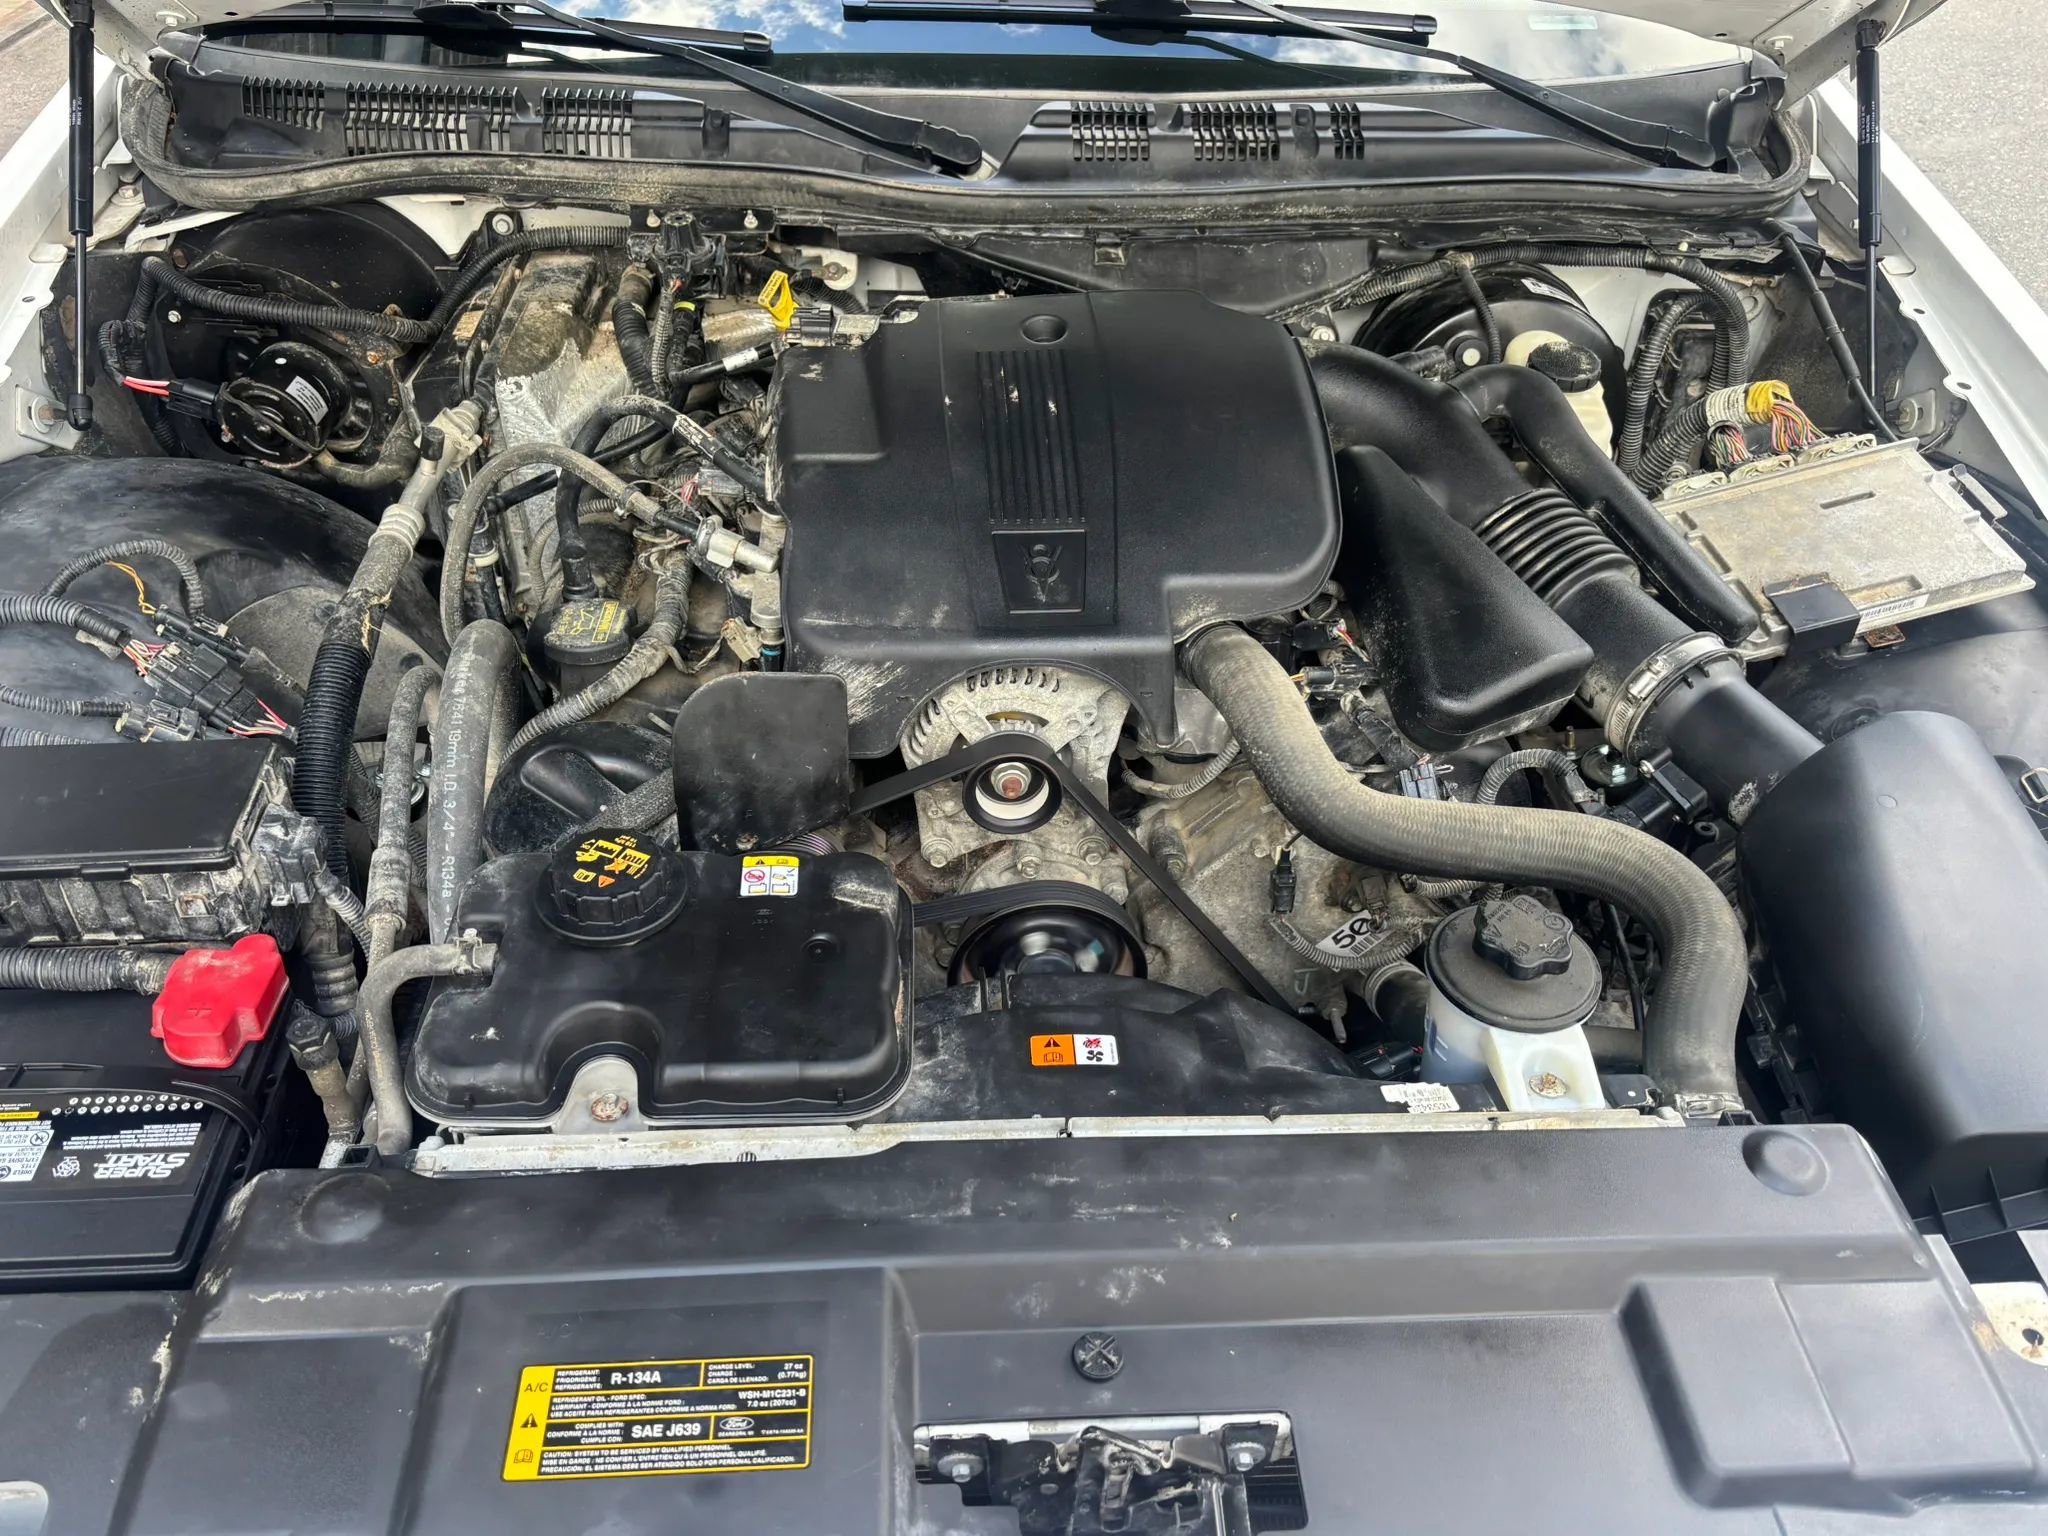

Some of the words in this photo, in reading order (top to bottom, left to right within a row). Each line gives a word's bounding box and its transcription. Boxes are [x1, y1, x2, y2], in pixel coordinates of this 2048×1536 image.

[446, 729, 462, 768] 19mm
[442, 856, 456, 898] R134a
[104, 1152, 191, 1167] START
[93, 1166, 174, 1179] SUPER
[611, 1371, 661, 1385] R-134A
[524, 1382, 549, 1393] A/C
[631, 1424, 664, 1438] SAE
[665, 1422, 702, 1437] J639
